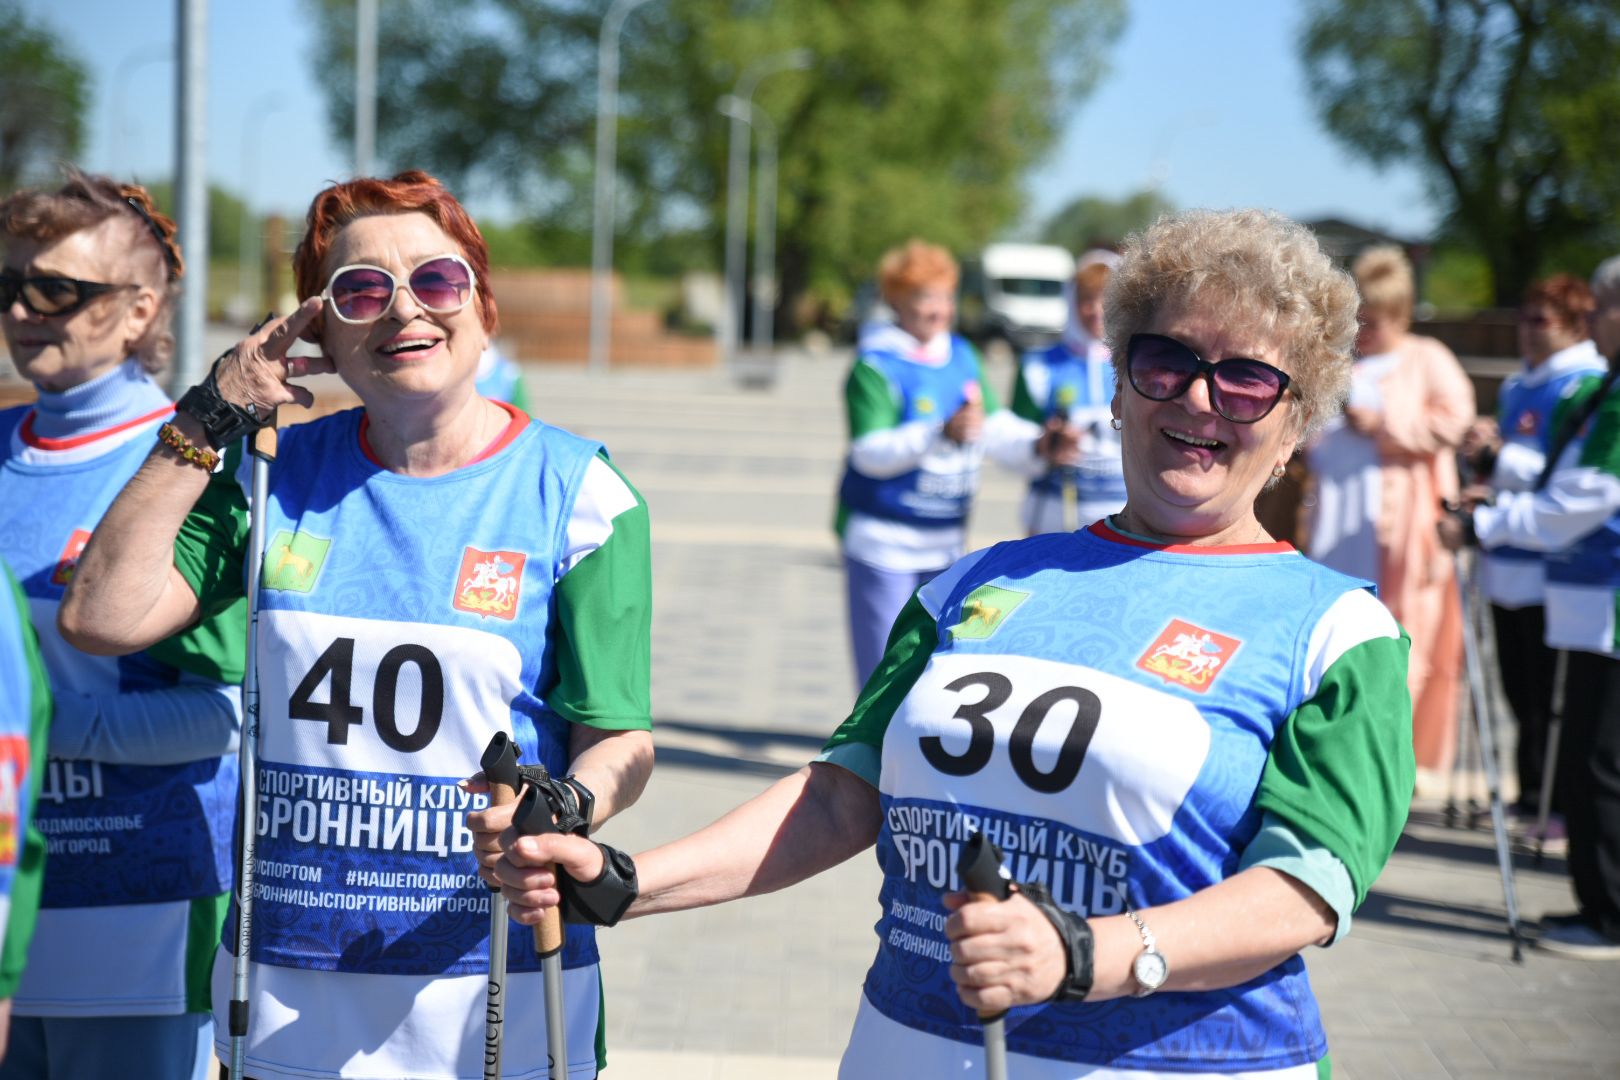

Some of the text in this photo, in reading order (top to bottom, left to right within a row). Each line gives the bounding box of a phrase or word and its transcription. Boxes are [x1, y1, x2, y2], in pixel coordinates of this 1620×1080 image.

[289, 637, 444, 753] 40
[919, 672, 1102, 794] 30
[259, 769, 489, 810] СПОРТИВНЫЙ КЛУБ
[46, 836, 111, 855] ЙГОРОД
[887, 806, 1128, 879] СПОРТИВНЫЙ КЛУБ
[241, 907, 253, 957] NORDIC
